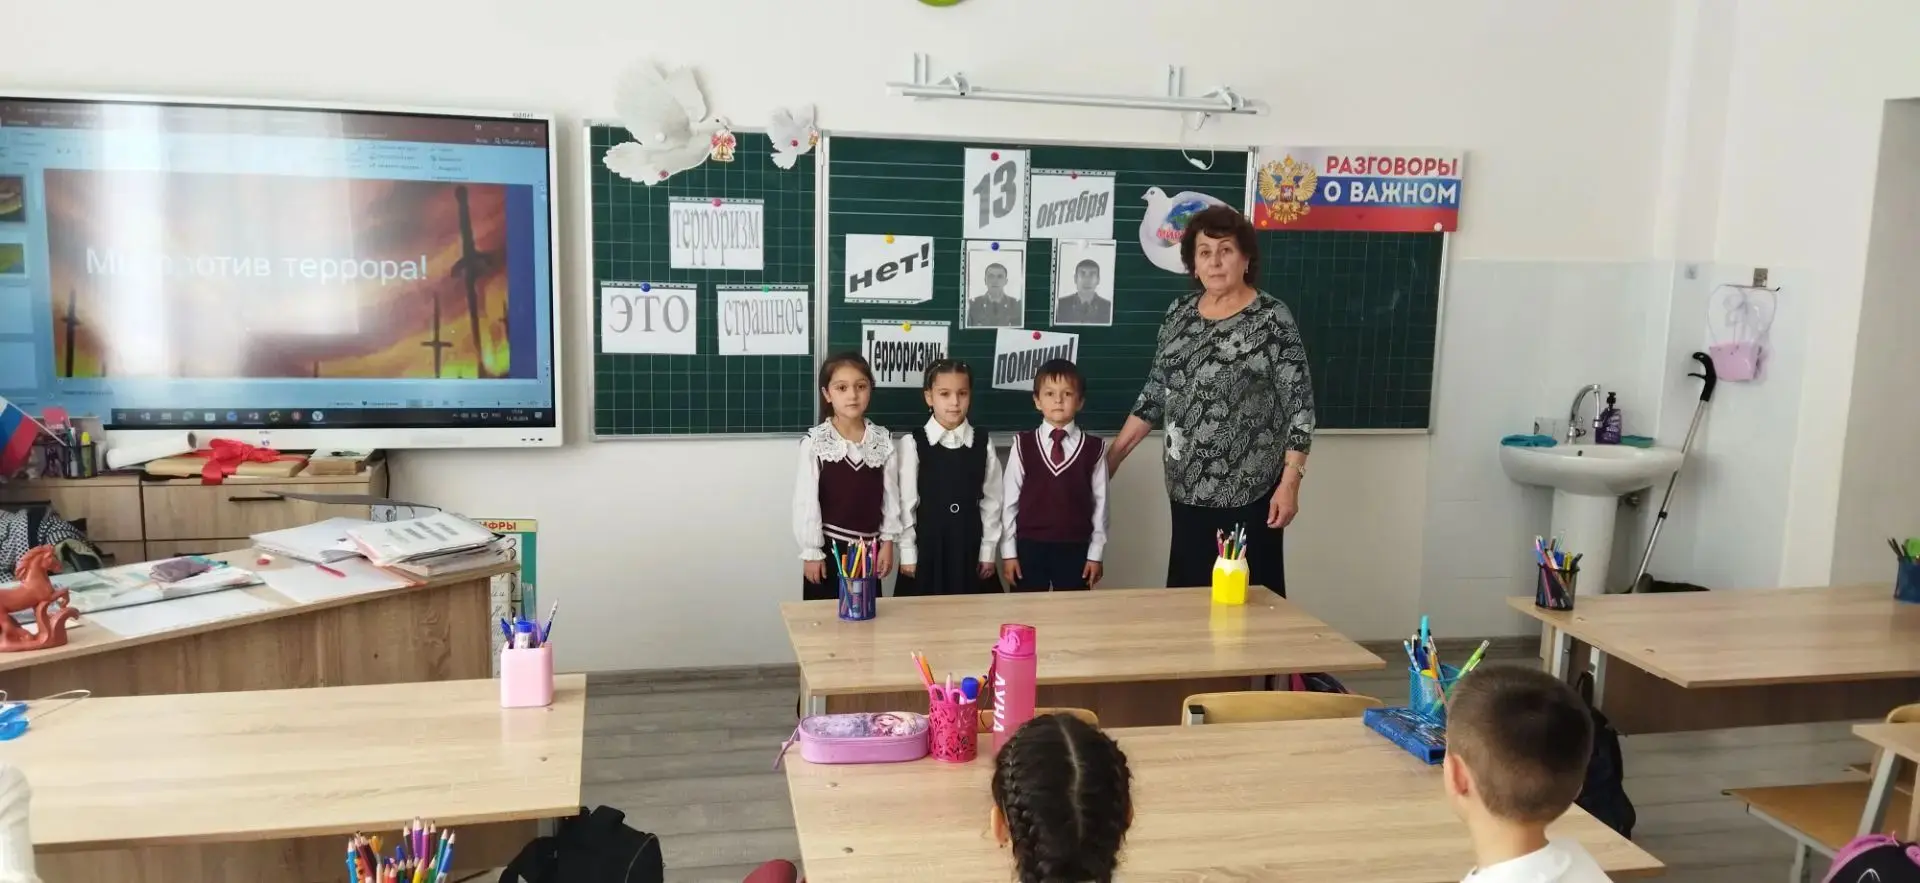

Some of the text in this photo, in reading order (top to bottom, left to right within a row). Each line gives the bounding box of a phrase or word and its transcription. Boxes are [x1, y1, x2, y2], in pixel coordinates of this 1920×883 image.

[1326, 155, 1458, 176] РАЗГОВОРЫ
[972, 160, 1017, 229] 13
[1036, 190, 1110, 230] октября
[1324, 180, 1457, 205] О ВАЖНОМ
[672, 207, 761, 266] терроризм
[282, 254, 428, 286] террора!
[849, 242, 930, 293] нет!
[723, 298, 804, 351] страшное
